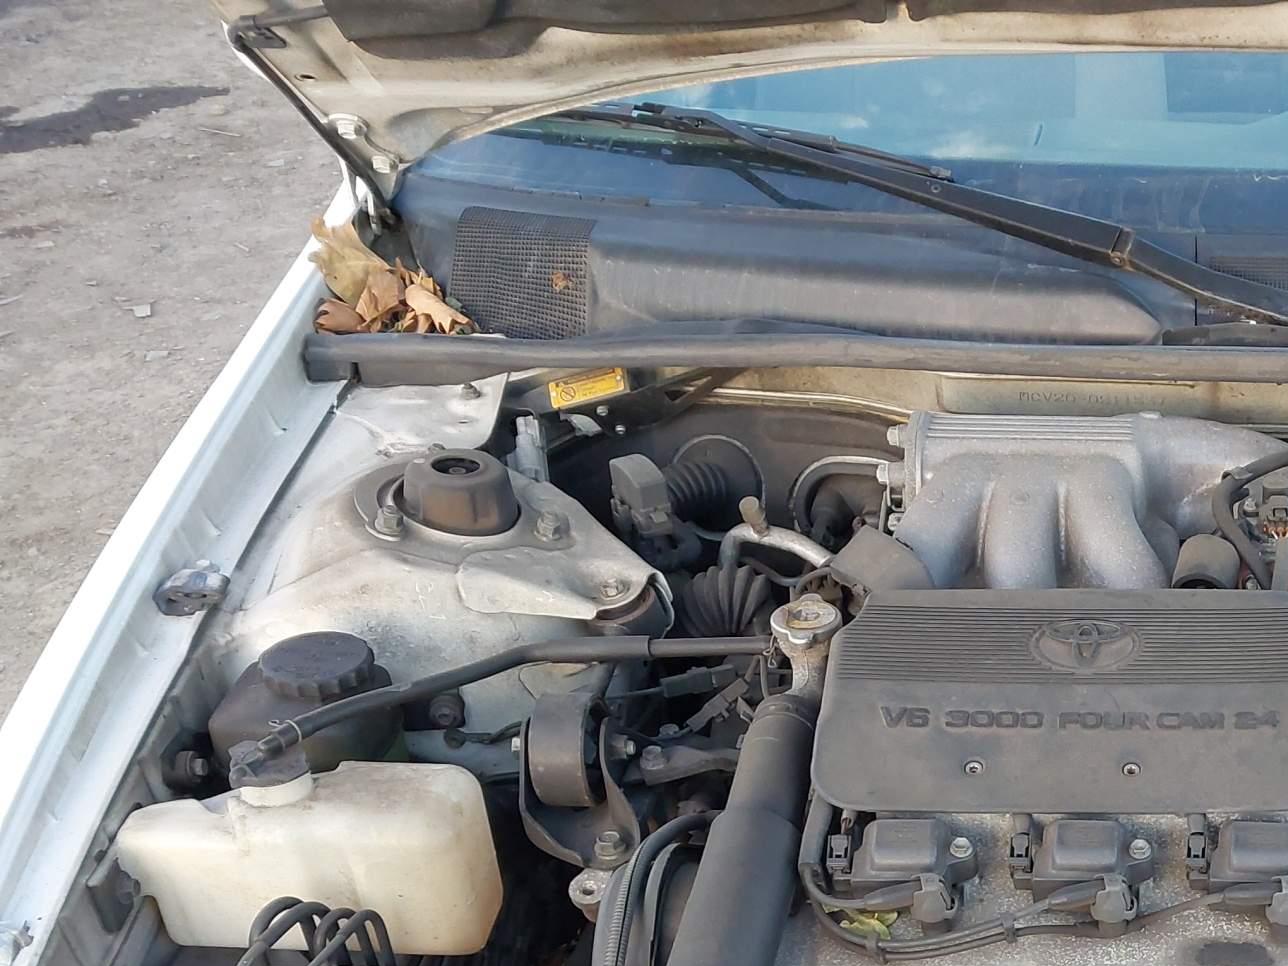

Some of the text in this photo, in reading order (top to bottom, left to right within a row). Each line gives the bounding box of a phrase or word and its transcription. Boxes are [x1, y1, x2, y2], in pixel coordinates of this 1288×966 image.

[880, 706, 1281, 731] V6 3000 FOUR CAM 24
